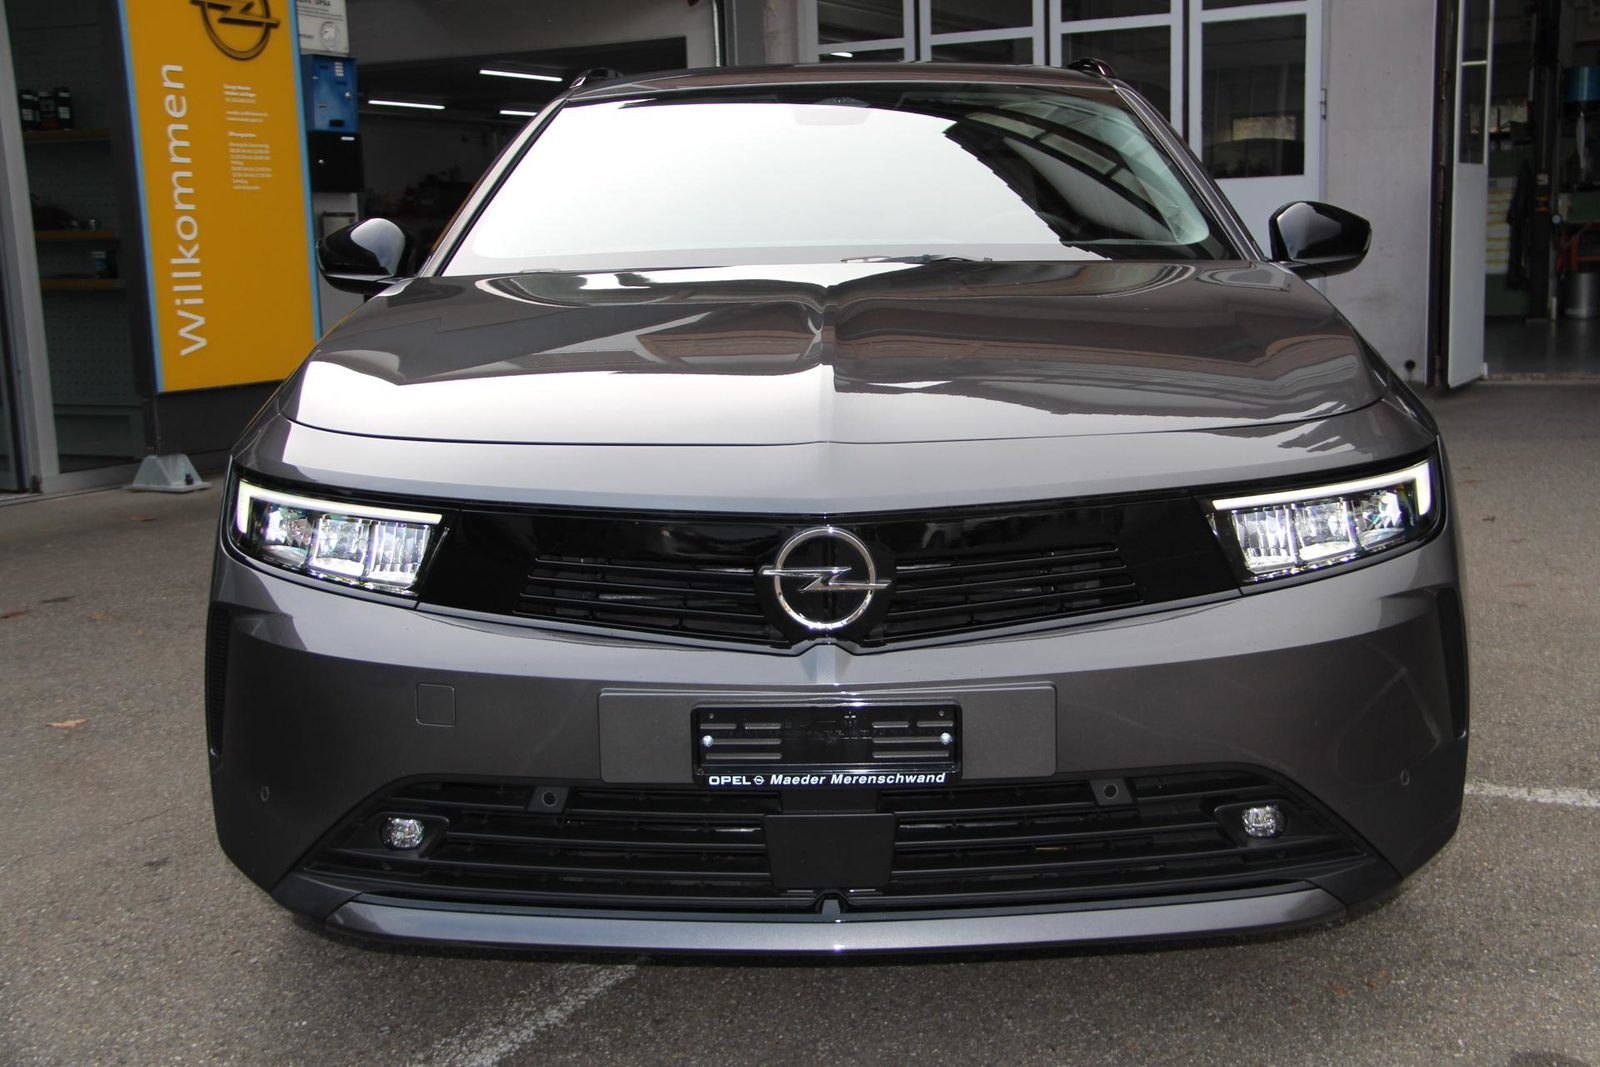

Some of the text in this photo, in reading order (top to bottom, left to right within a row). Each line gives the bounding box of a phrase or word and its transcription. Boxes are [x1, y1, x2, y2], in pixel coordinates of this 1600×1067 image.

[161, 64, 207, 355] Willkommen
[709, 772, 946, 785] OPEL Maeder Merenschwand
